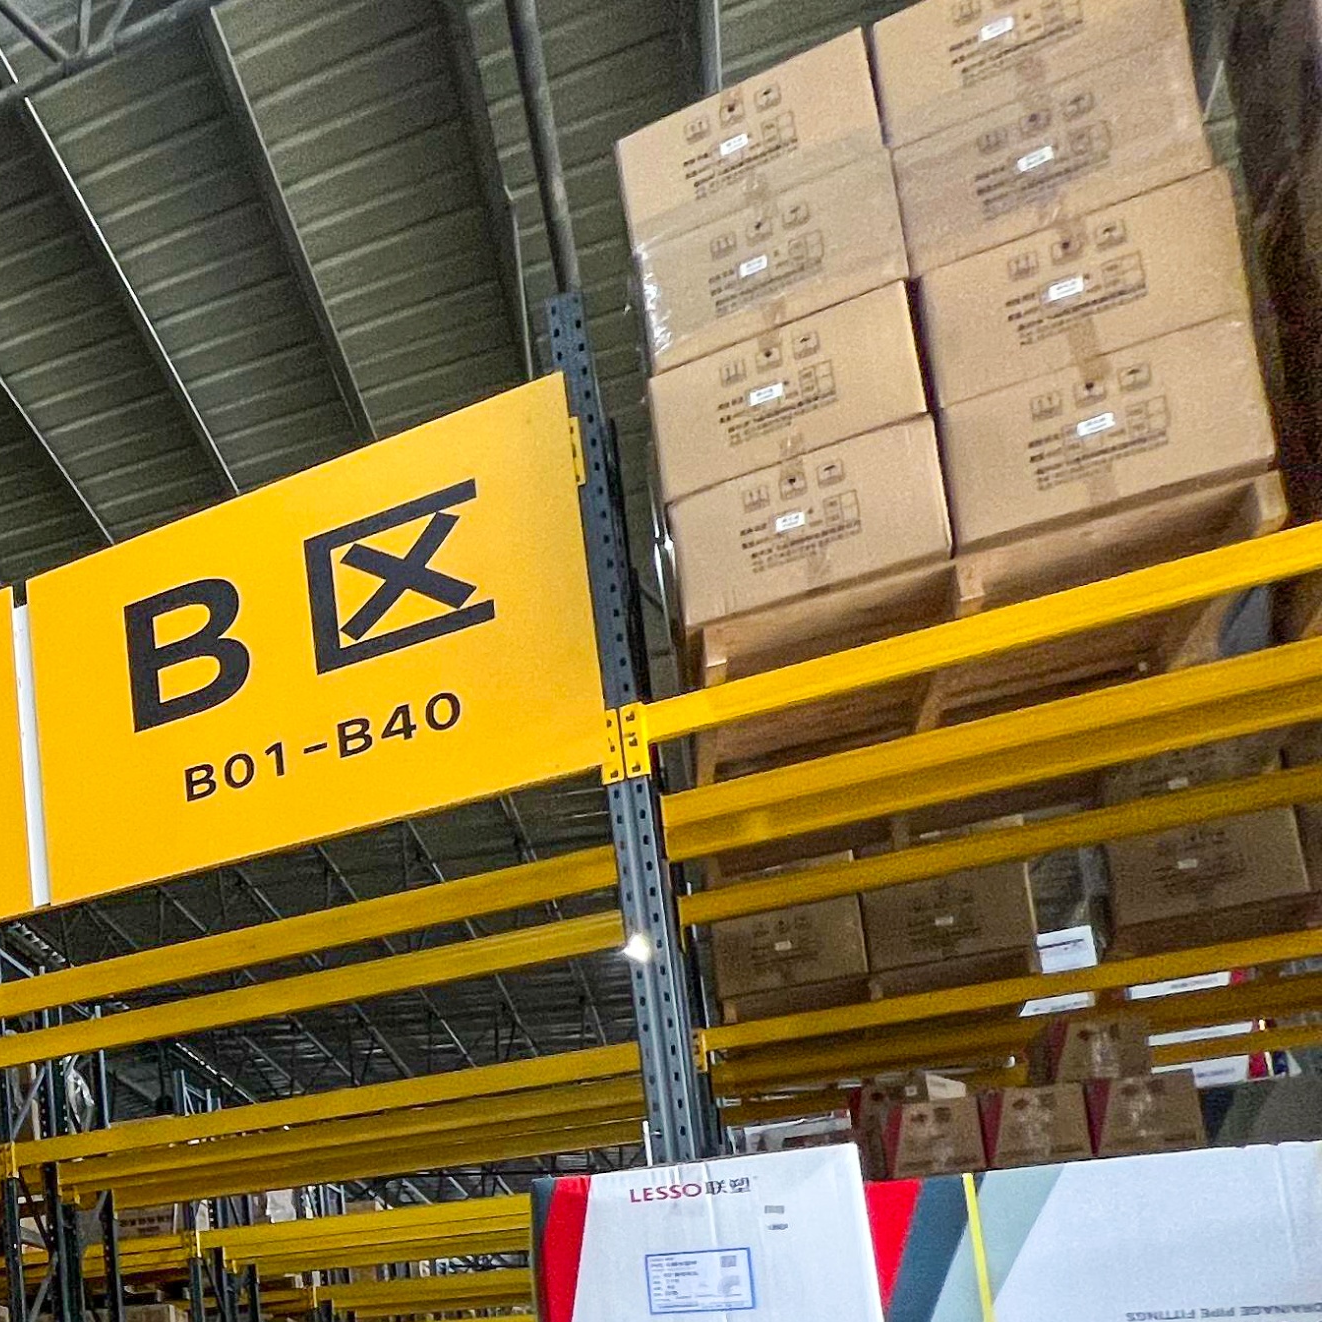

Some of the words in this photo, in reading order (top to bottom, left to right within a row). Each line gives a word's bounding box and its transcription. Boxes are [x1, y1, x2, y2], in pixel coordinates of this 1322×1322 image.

[124, 578, 250, 733] B
[303, 479, 495, 675] 区
[184, 692, 462, 802] B01-B40
[630, 1183, 702, 1203] LESSO
[1125, 1308, 1196, 1322] FITTINGS
[1200, 1306, 1236, 1319] PIPE
